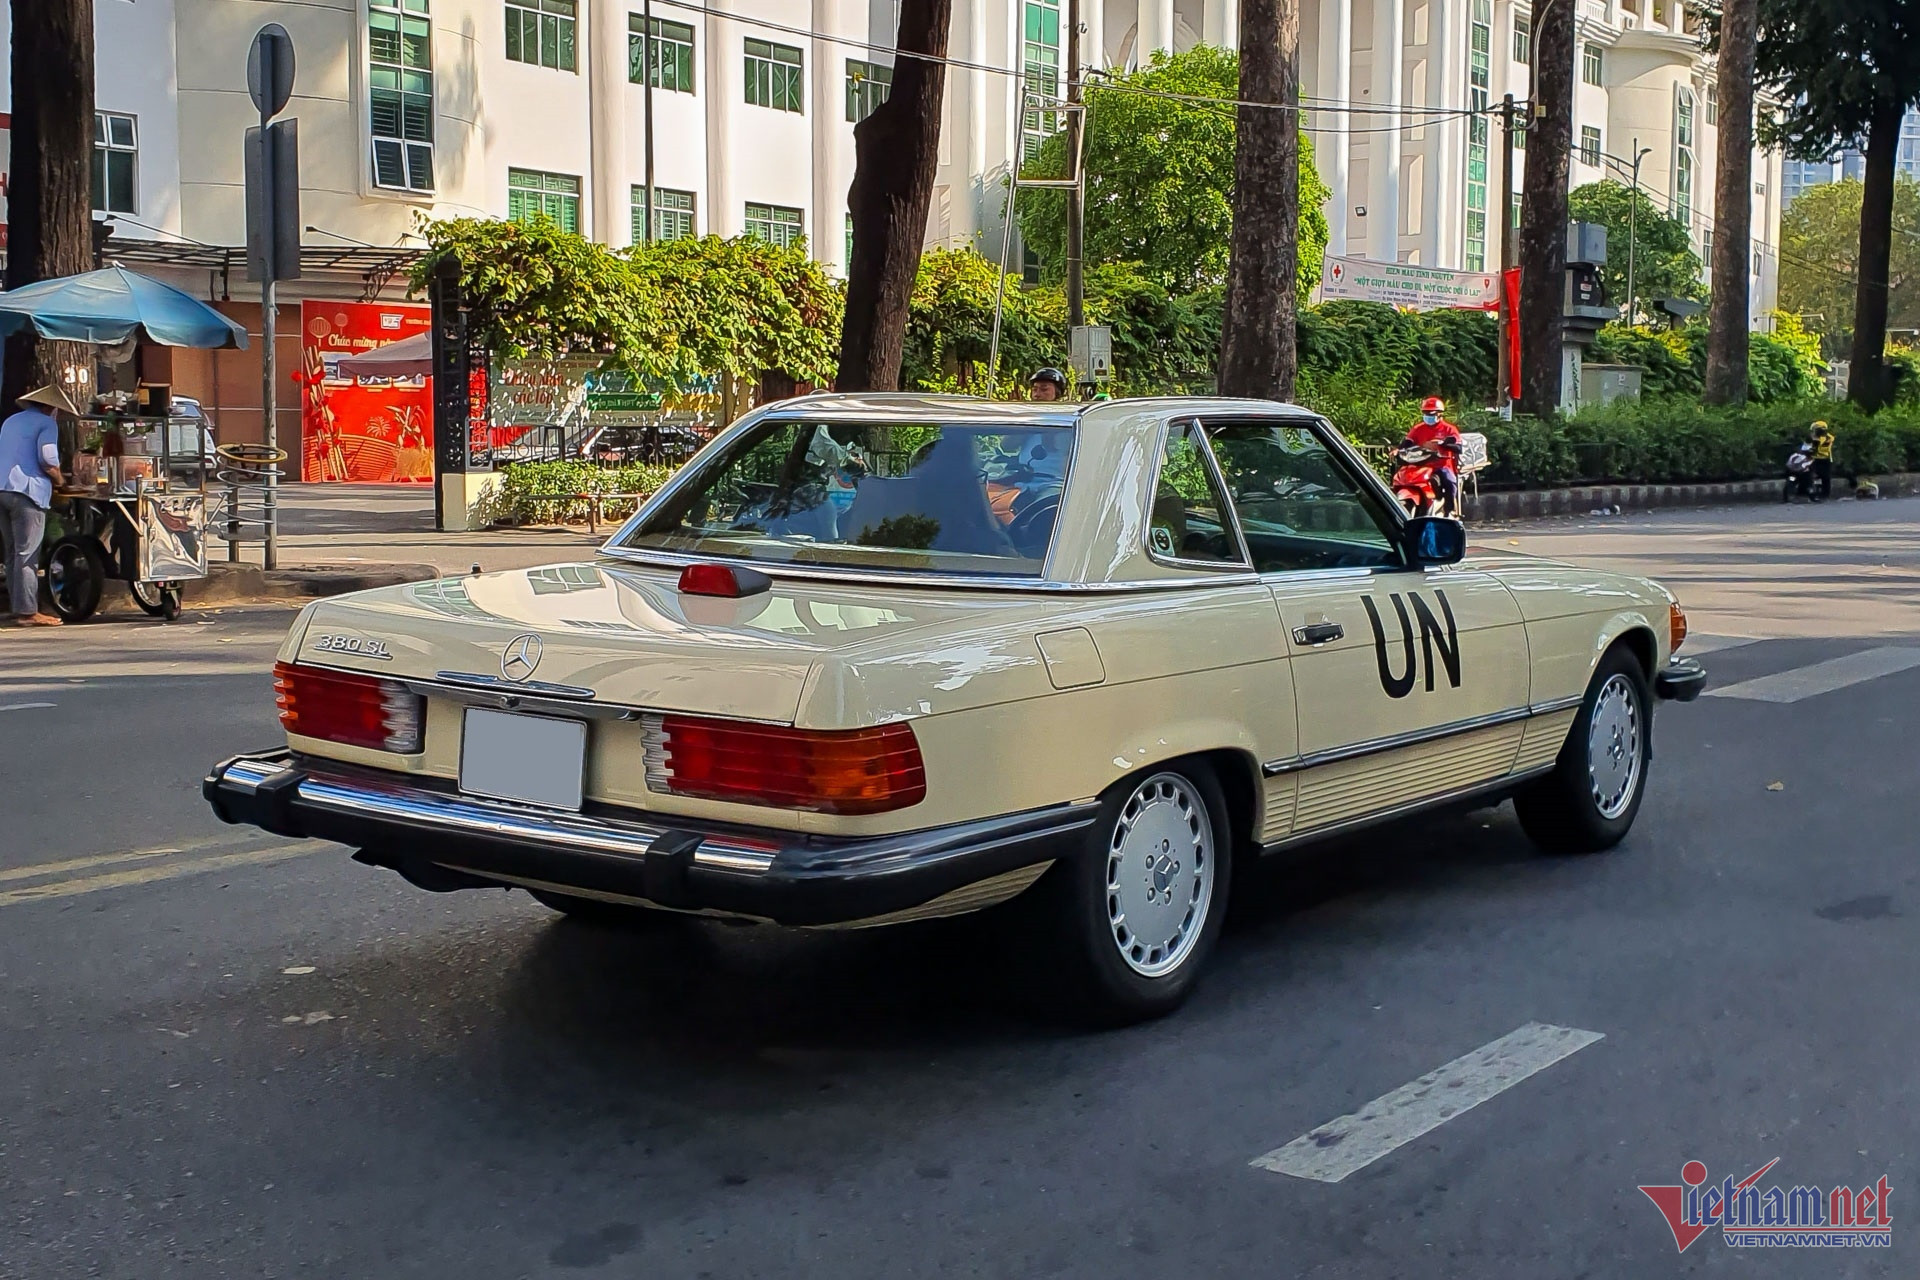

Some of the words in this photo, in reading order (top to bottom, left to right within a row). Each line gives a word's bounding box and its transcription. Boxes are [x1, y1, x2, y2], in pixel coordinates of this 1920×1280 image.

[328, 333, 351, 347] Chúc
[353, 336, 378, 350] mừng
[320, 634, 361, 651] 380
[366, 640, 389, 655] SL
[1360, 589, 1461, 699] UN
